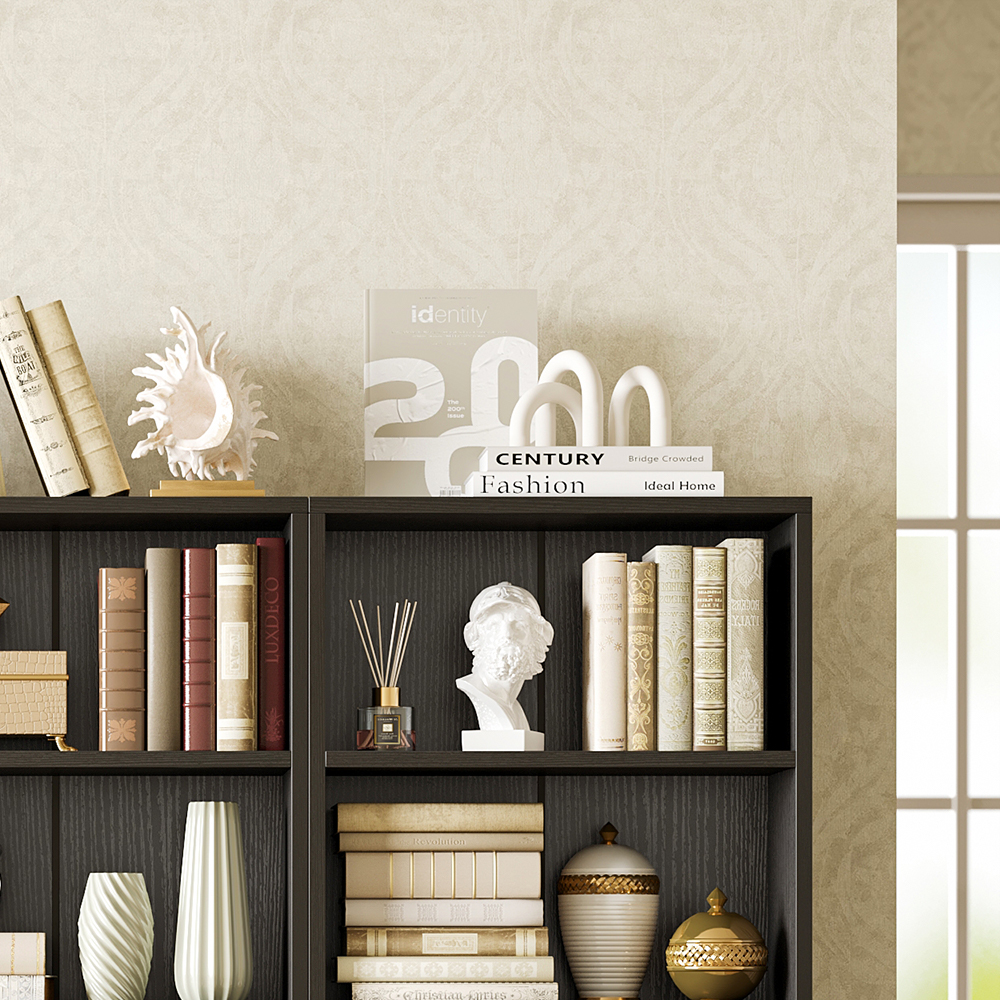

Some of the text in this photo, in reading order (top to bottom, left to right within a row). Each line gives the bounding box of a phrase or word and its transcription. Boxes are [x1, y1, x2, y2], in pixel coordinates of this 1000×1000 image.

[411, 305, 487, 327] identity
[495, 453, 704, 466] CENTURY Bridge Crowded
[480, 475, 716, 494] Fashion Ideal Home
[264, 577, 280, 663] LUXDECO
